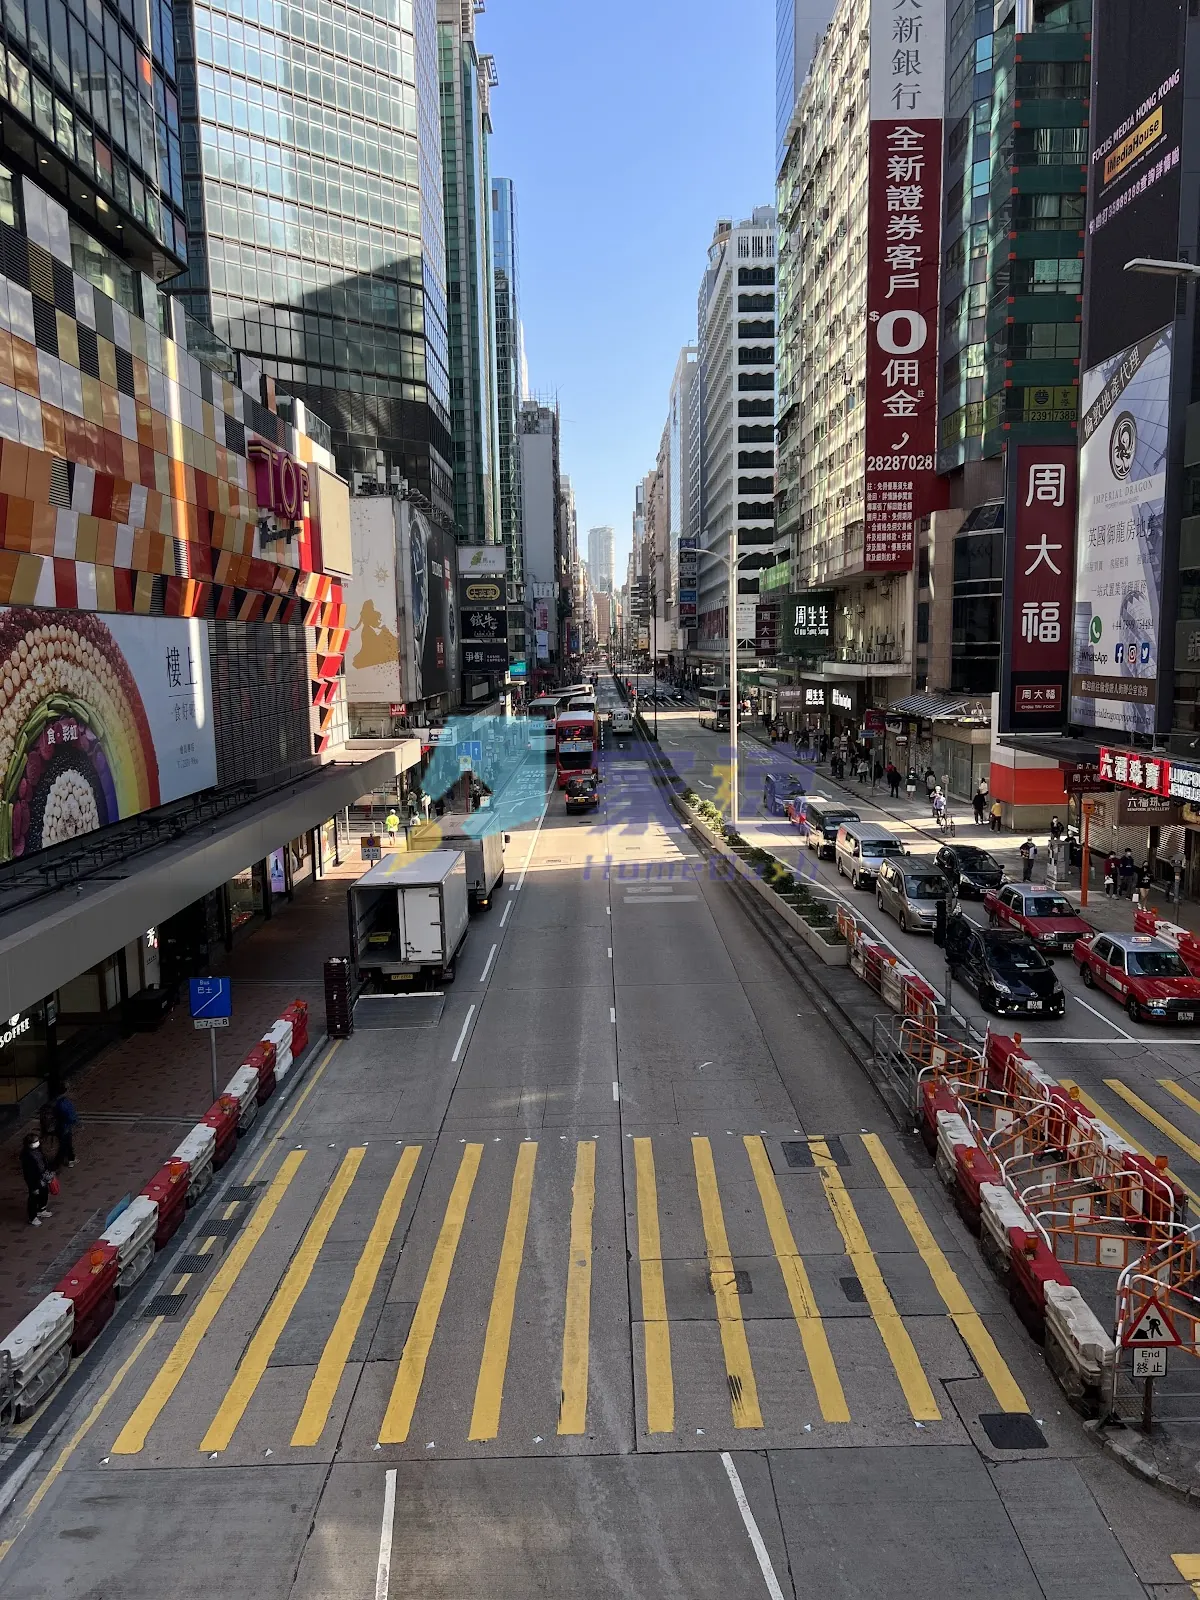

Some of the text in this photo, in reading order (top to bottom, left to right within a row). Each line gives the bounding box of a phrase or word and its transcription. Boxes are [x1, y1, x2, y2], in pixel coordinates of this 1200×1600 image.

[1092, 68, 1180, 164] FOCUS MEDIA HONG KONG
[884, 126, 925, 299] 全新證券客戶
[882, 359, 921, 417] 佣金
[1084, 345, 1140, 438] 倫敦地產代理
[1031, 409, 1076, 421] 2391 7389
[867, 455, 933, 471] 28287028
[248, 440, 310, 520] TOP
[1093, 488, 1122, 504] IMPERIAL
[1125, 480, 1153, 496] DRAGON
[1021, 463, 1067, 644] 周大福
[795, 606, 829, 627] 周生生
[166, 647, 198, 688] 樓上
[1080, 651, 1108, 664] WhatsApp
[1021, 689, 1056, 700] 周大福
[391, 704, 405, 712] JM
[1100, 753, 1159, 790] 六福珠寶
[1168, 766, 1200, 788] LUKFO
[197, 986, 213, 994] 巴士
[1141, 1350, 1160, 1358] End
[1136, 1362, 1163, 1374] 終止
